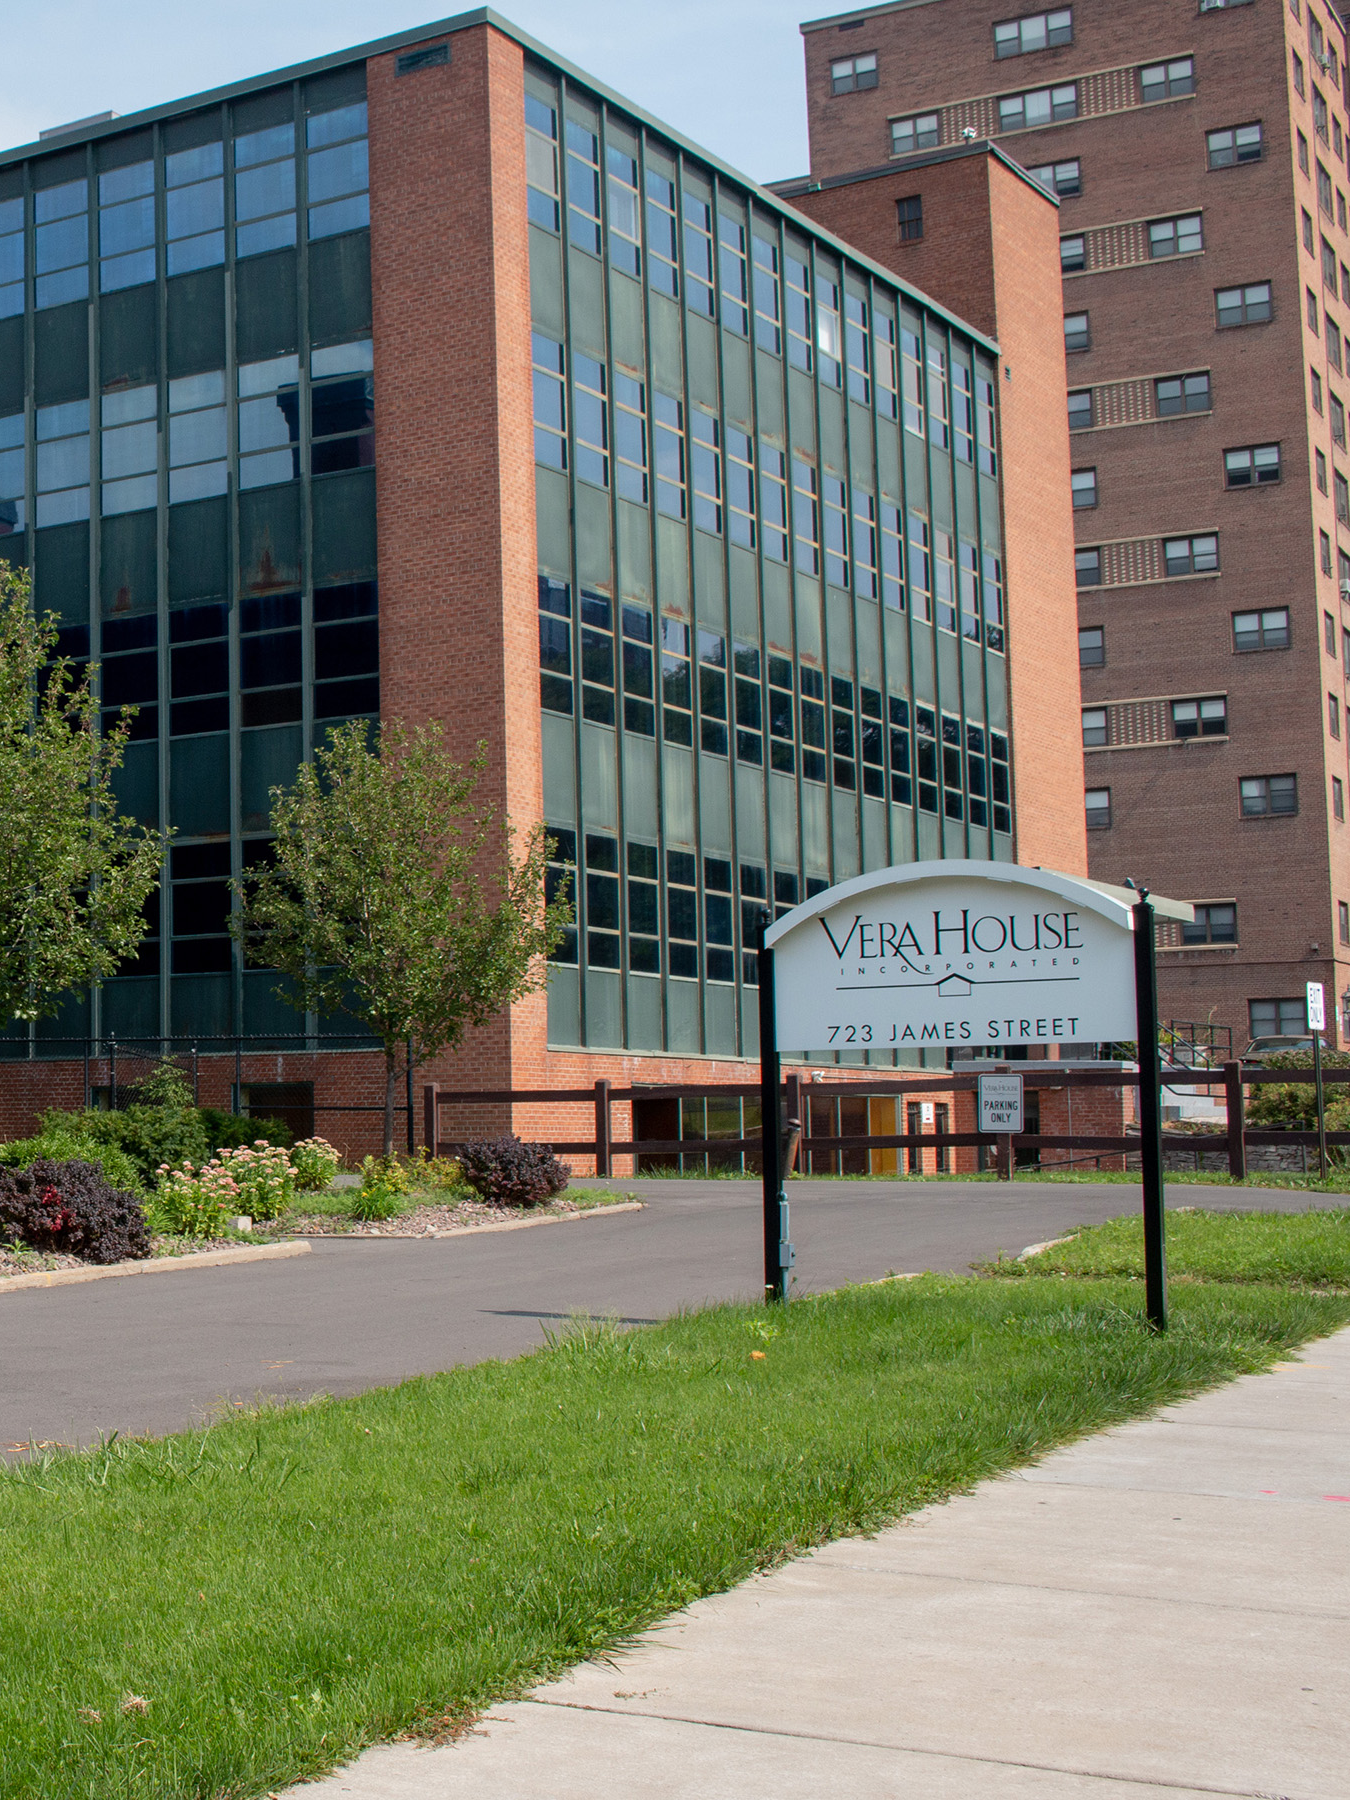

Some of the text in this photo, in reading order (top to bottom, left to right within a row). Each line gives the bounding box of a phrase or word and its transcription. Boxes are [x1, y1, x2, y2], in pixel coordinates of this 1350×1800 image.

[818, 909, 1084, 974] VERA HOUSE
[840, 957, 1081, 976] INCORPORATED
[827, 1017, 1080, 1044] 723 JAMES STREET
[983, 1084, 1019, 1092] VERA HOUSE
[983, 1100, 1018, 1111] PARKING
[990, 1112, 1011, 1123] ONLY
